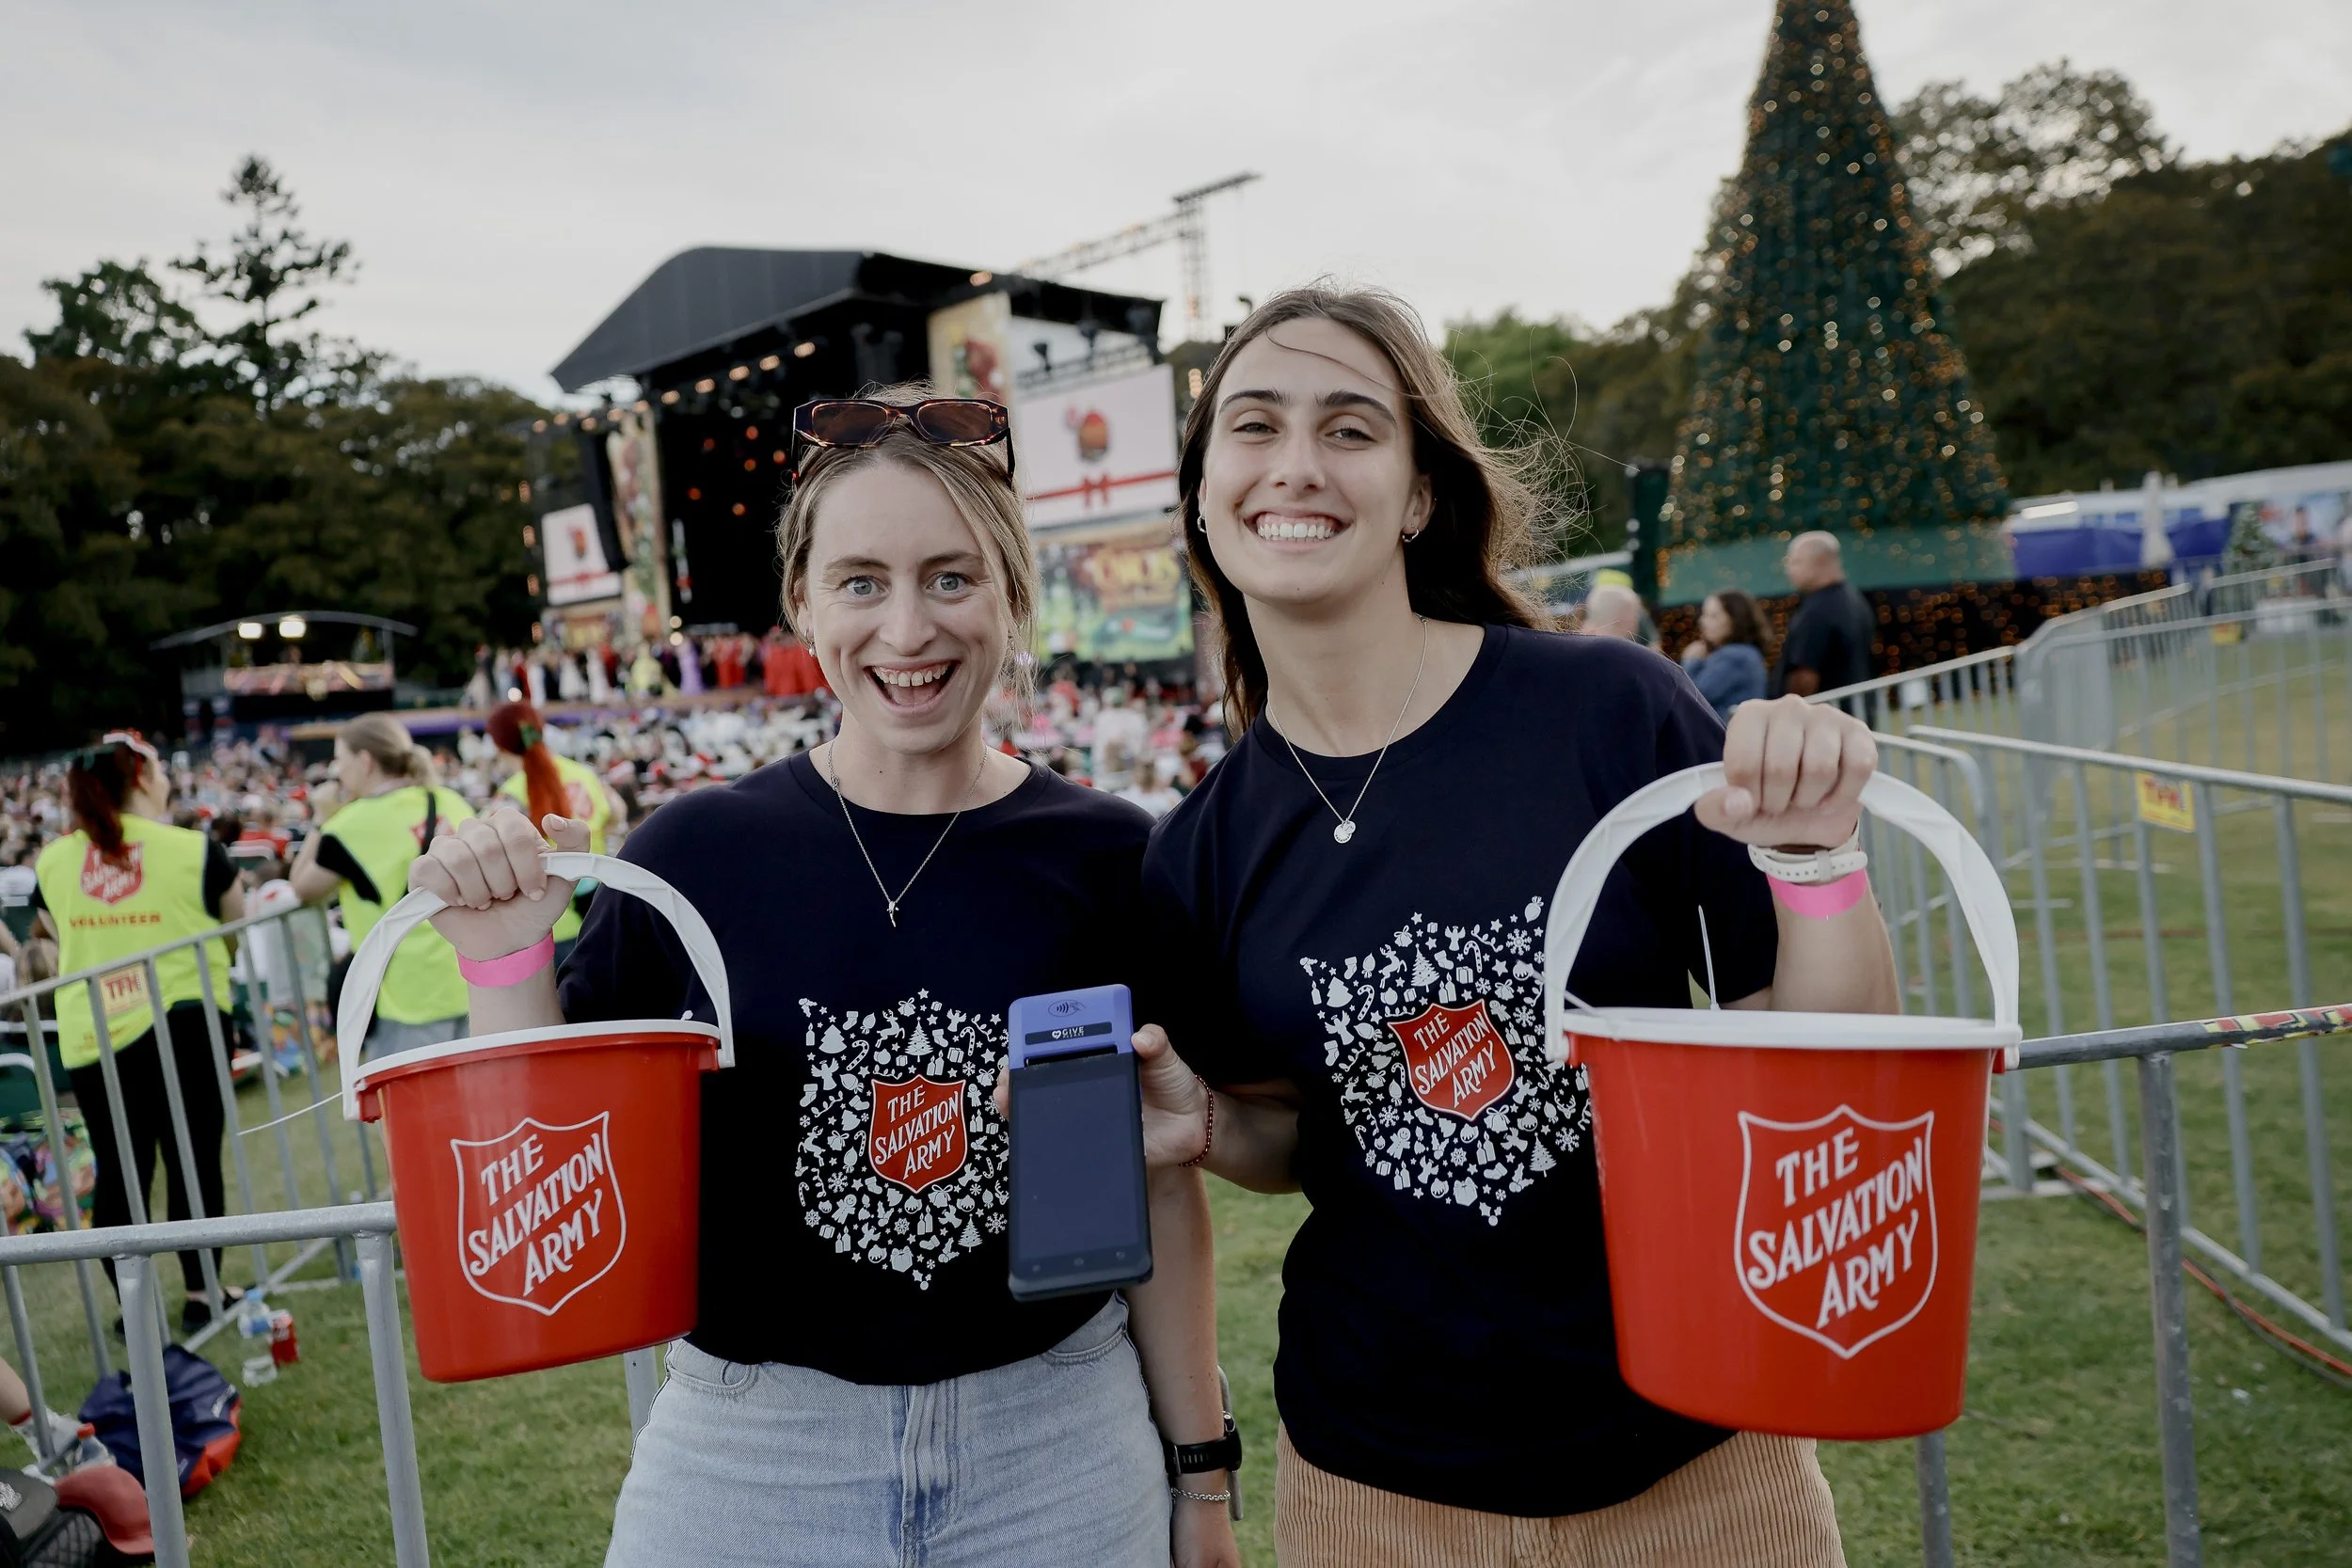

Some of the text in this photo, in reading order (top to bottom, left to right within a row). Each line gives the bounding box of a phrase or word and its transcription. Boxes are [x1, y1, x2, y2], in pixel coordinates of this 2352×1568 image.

[70, 912, 161, 928] VOLUNTEER
[1062, 1026, 1084, 1036] GIVE
[1414, 1012, 1450, 1051] THE
[1415, 1011, 1491, 1095] SALVATION
[887, 1085, 926, 1123] THE
[1453, 1040, 1496, 1108] ARMY
[875, 1091, 958, 1164] SALVATION
[903, 1125, 955, 1180] ARMY
[468, 1132, 604, 1276] SALVATION
[481, 1133, 544, 1206] THE
[1775, 1127, 1860, 1208] THE
[523, 1188, 602, 1297] ARMY
[1747, 1137, 1922, 1290] SALVATION
[1817, 1209, 1919, 1330] ARMY
